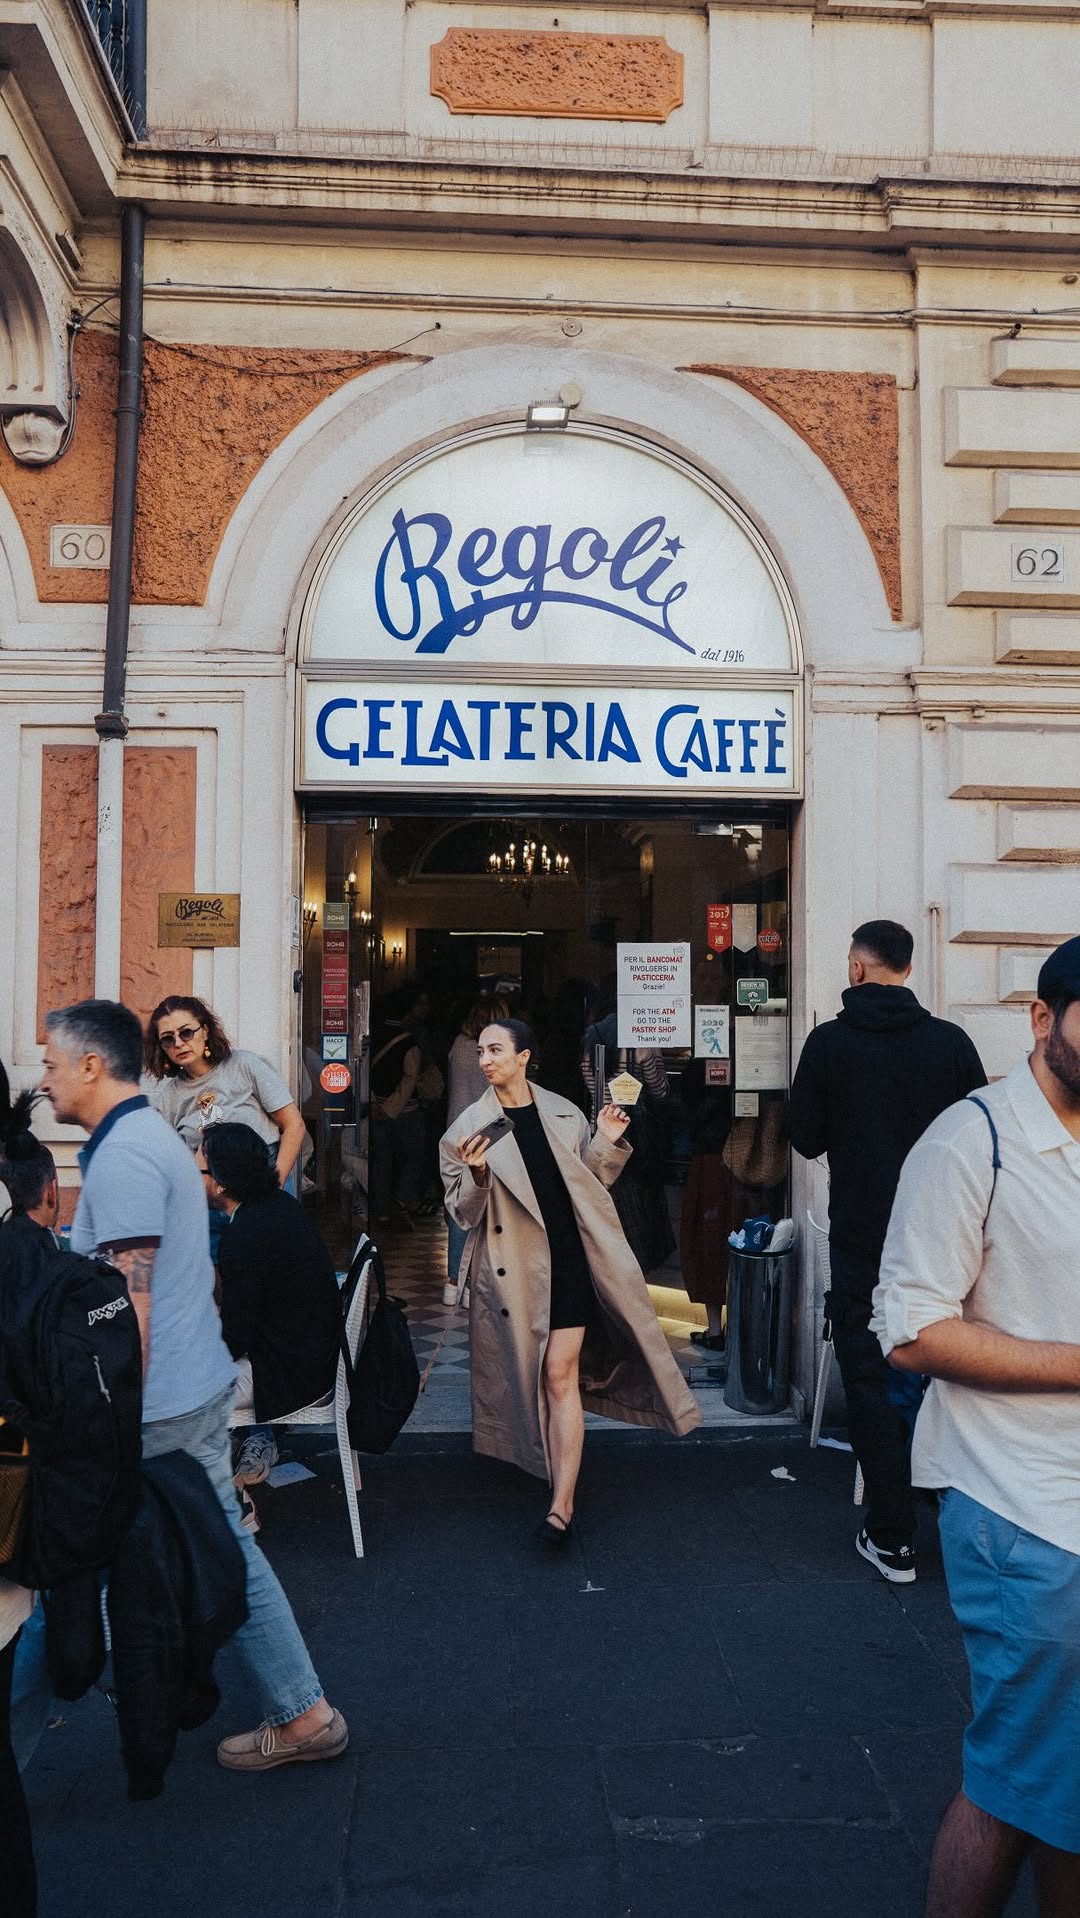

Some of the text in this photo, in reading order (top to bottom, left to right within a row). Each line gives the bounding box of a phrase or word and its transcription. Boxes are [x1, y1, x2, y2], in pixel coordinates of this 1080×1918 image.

[60, 532, 105, 560] 60
[1016, 548, 1060, 576] 62
[376, 507, 697, 653] Regoli
[701, 648, 745, 662] dal 1916
[316, 697, 787, 778] GELATERIA CAFFÈ
[175, 898, 226, 920] Regoli
[709, 910, 730, 919] 2017
[701, 1019, 724, 1027] 2020
[658, 1035, 672, 1043] you!
